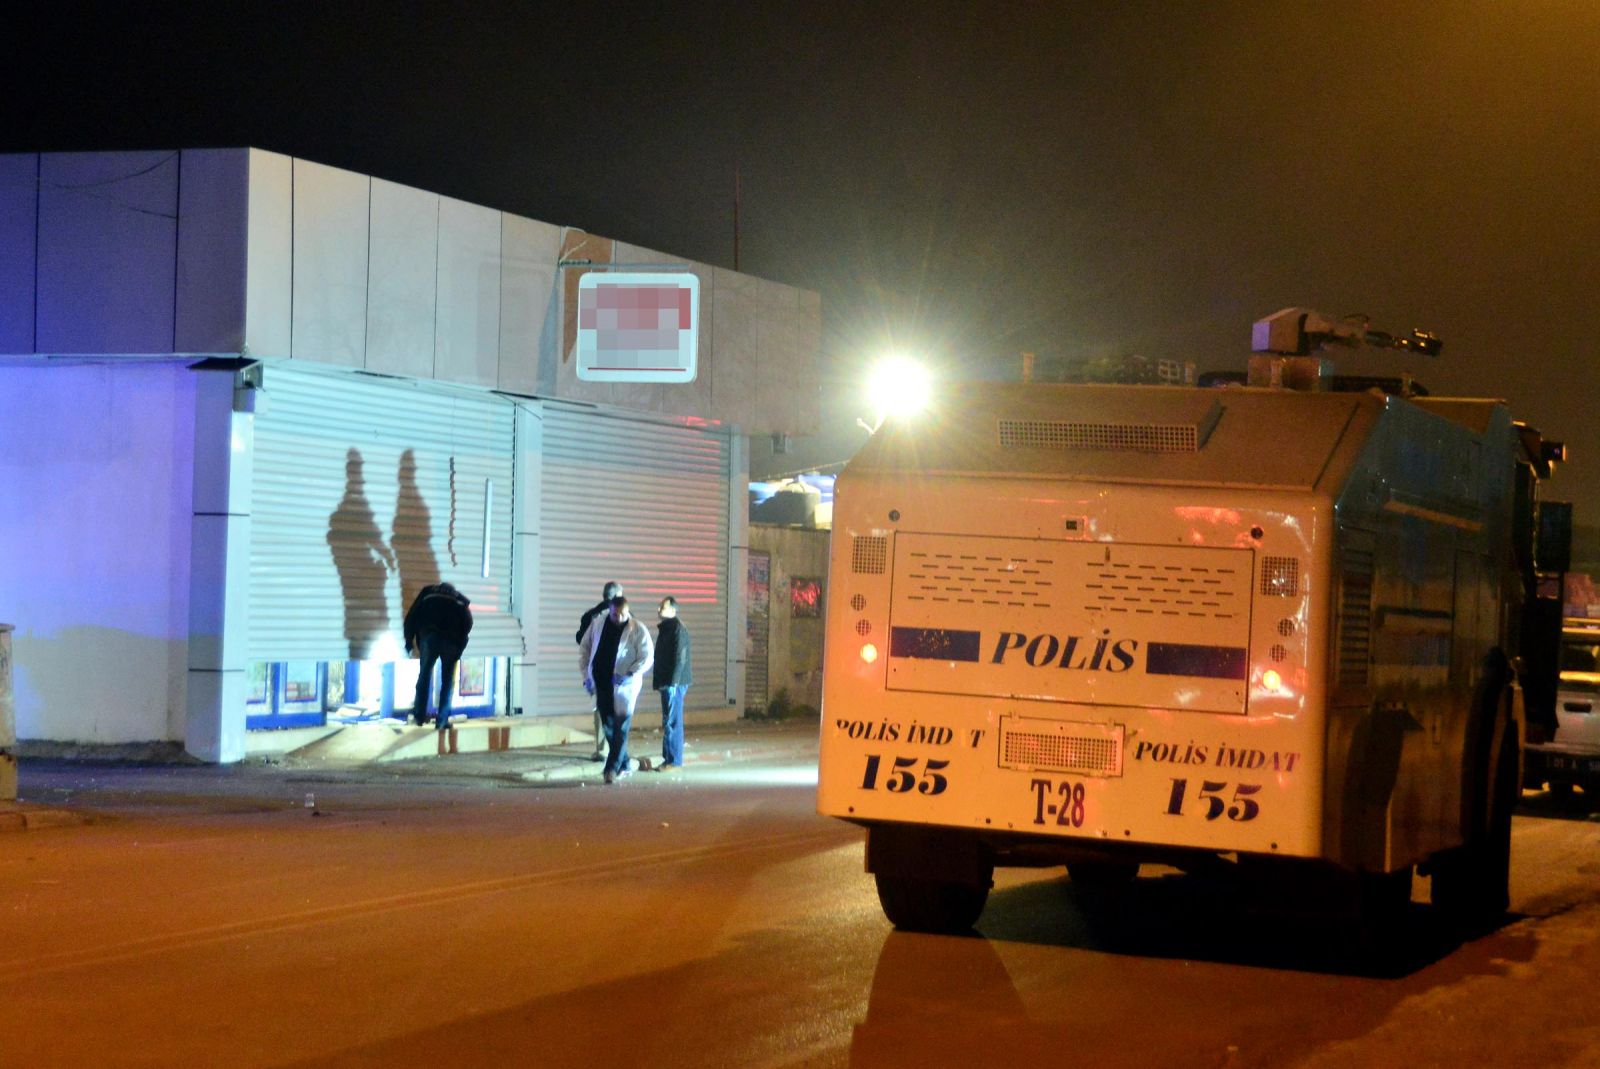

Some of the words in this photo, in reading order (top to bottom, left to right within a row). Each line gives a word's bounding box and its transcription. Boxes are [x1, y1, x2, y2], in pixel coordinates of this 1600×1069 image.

[989, 629, 1137, 672] POLİS
[907, 719, 985, 748] İMDT
[858, 754, 951, 796] 155
[1134, 740, 1209, 765] POLİS
[1215, 743, 1301, 772] İMDAT
[1030, 779, 1086, 828] T-28
[1164, 778, 1262, 821] 155
